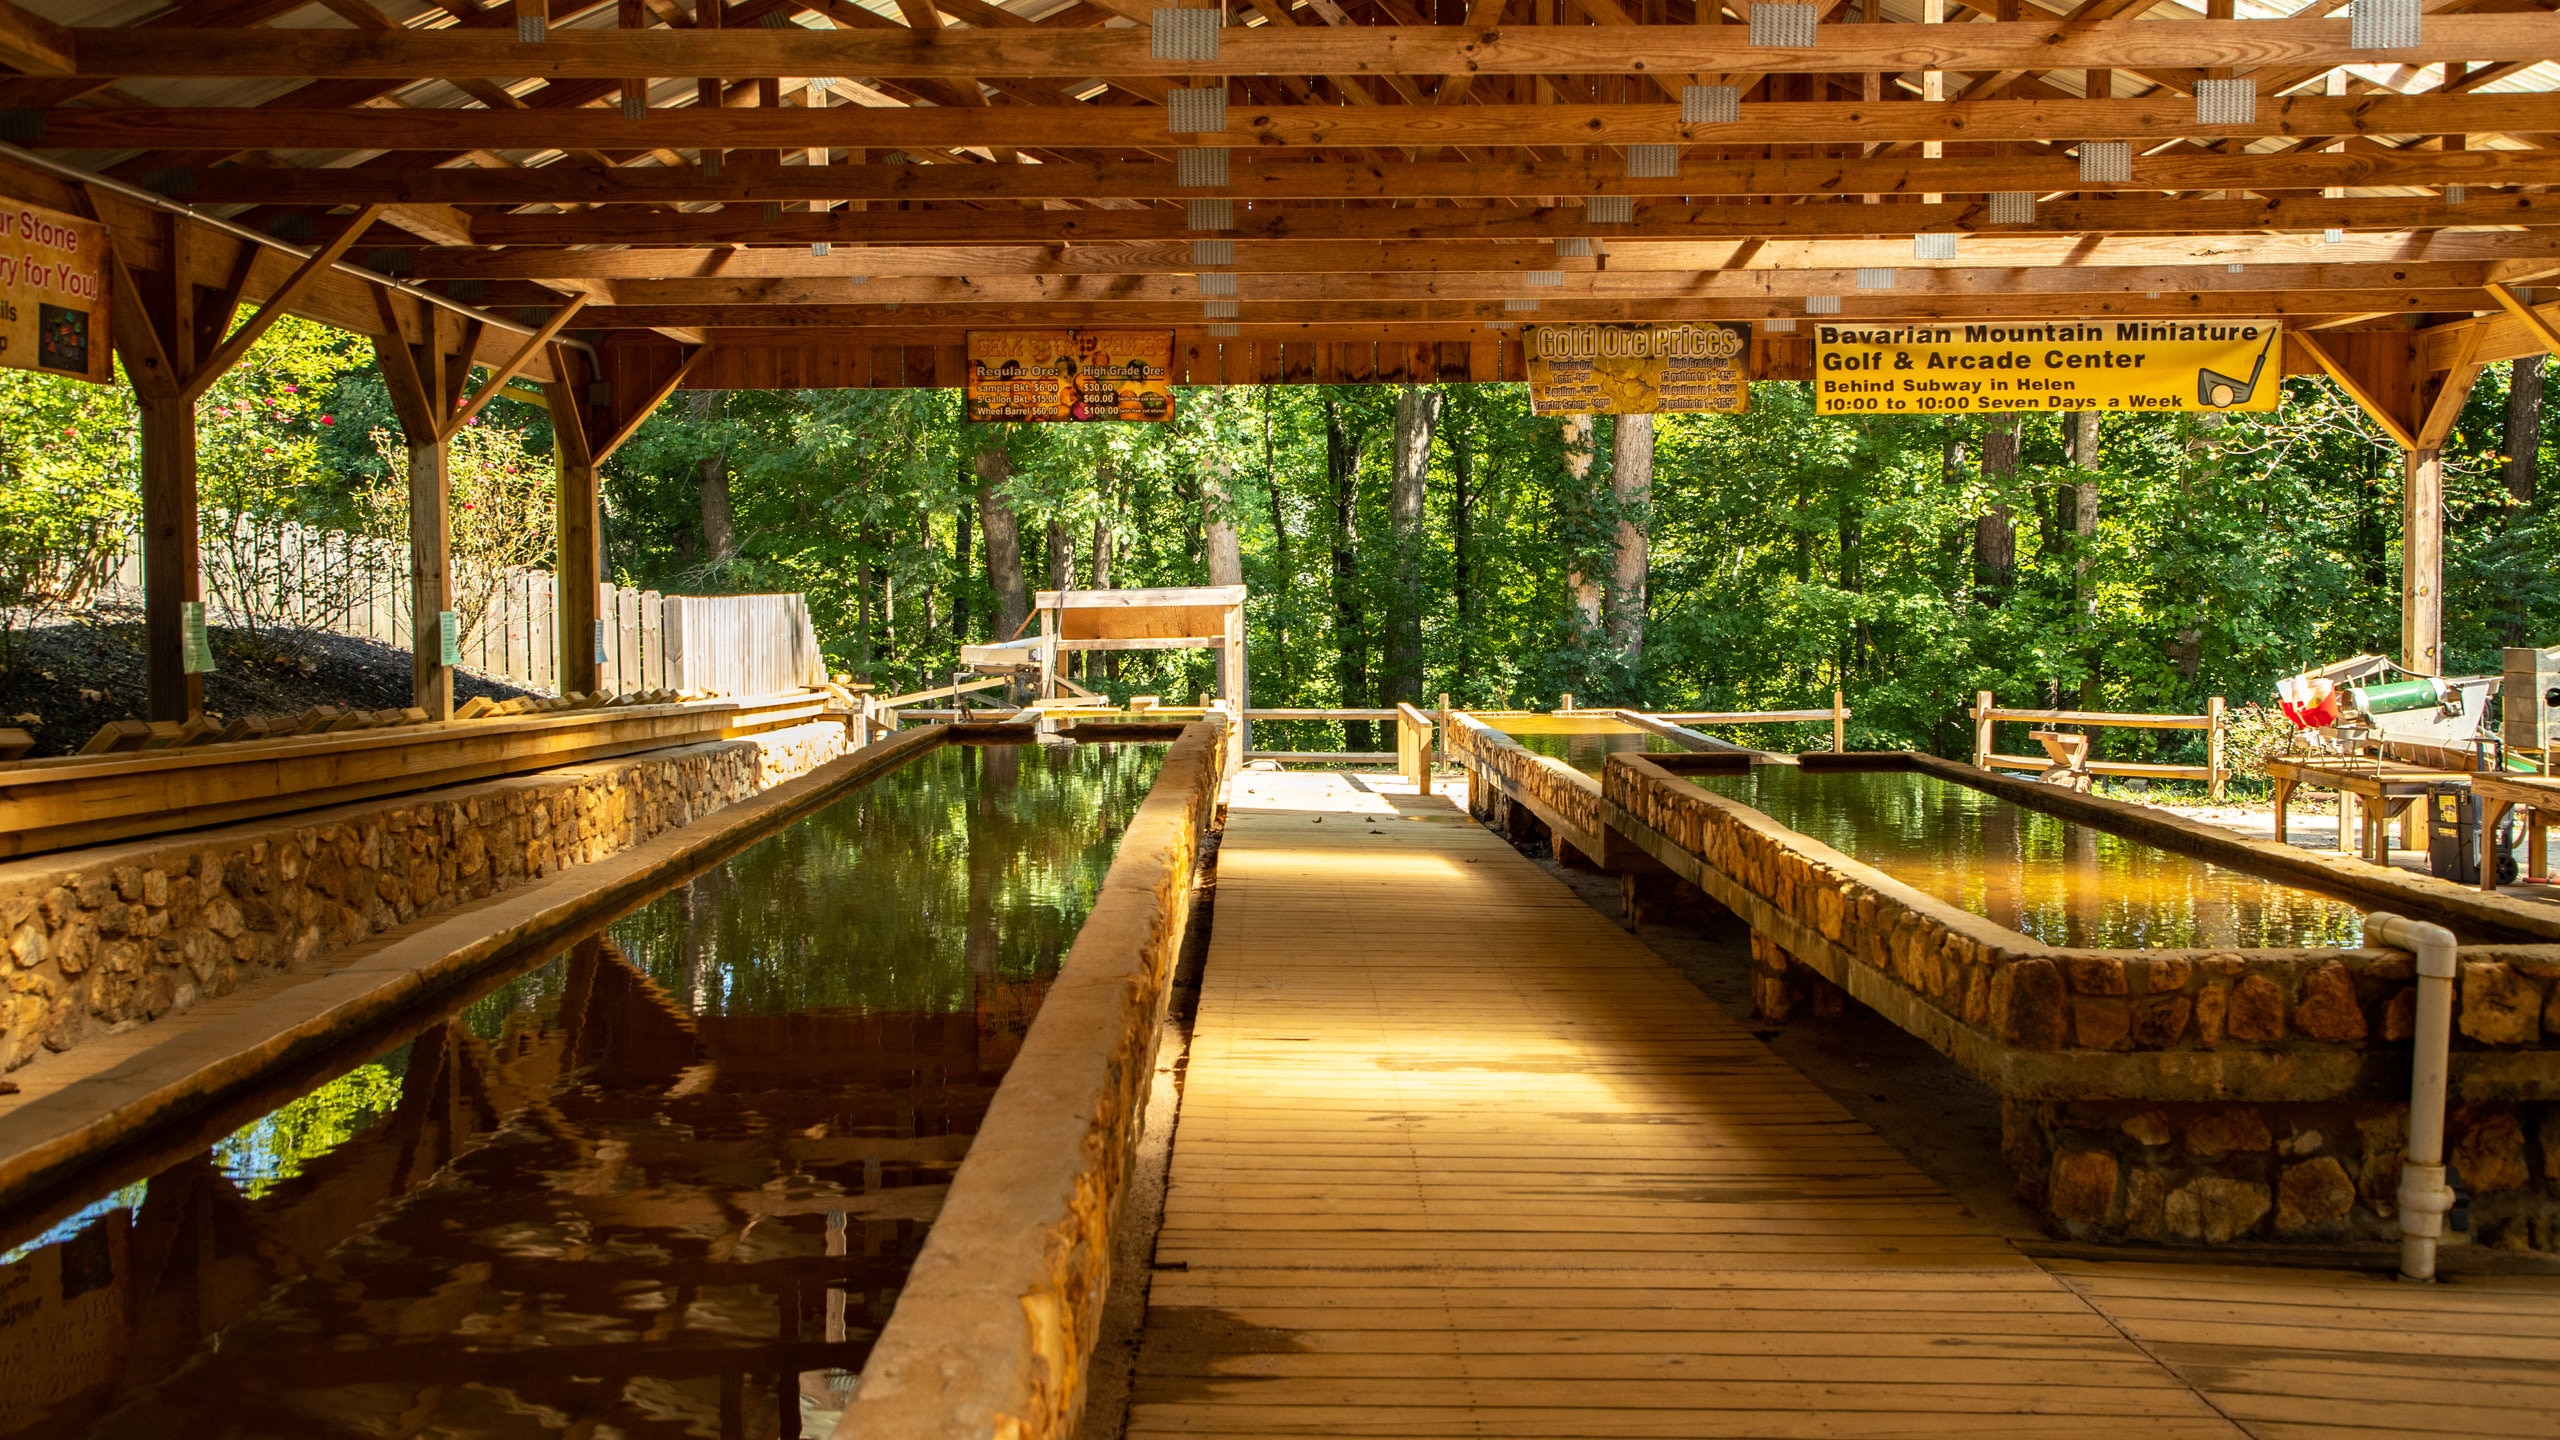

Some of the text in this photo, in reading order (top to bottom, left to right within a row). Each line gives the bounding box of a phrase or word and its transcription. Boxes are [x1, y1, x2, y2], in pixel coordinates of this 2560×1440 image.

[20, 211, 77, 252] Stone
[24, 256, 51, 287] for
[57, 263, 98, 299] You!
[1821, 322, 2258, 344] Bavarian Mountain Miniature
[977, 334, 1167, 357] GEM STONE PRICES
[1539, 326, 1737, 357] Gold Ore Prices
[1549, 360, 1579, 371] Regular
[1669, 357, 1729, 368] High Grade Ore
[1823, 350, 2145, 371] Golf & Arcade Center
[976, 366, 1059, 378] Regular Ore:
[1083, 366, 1164, 377] High Grade Ore:
[1661, 371, 1670, 381] 15
[1671, 371, 1696, 381] gallon
[1697, 371, 1706, 381] to
[977, 383, 1058, 392] sample Bkt. $6.00
[1083, 383, 1113, 392] $30.00
[1545, 386, 1551, 397] 5
[1552, 386, 1576, 397] gallon
[1660, 385, 1671, 395] 30
[1672, 384, 1697, 395] gallon
[1698, 384, 1707, 395] to
[1824, 378, 2075, 394] Behind Subway in Helen
[977, 395, 1058, 403] 5 Gallon Bkt. $15.00
[1083, 394, 1113, 403] $60.00
[1668, 398, 1694, 409] gallon
[1695, 398, 1703, 408] to
[1825, 395, 2183, 411] 10:00 to 10:00 Seven Days a Week
[1536, 400, 1562, 410] Tractor
[1563, 399, 1587, 410] Scoop
[977, 407, 1058, 415] Wheel Barrel $60.00
[1083, 406, 1118, 415] $100.00
